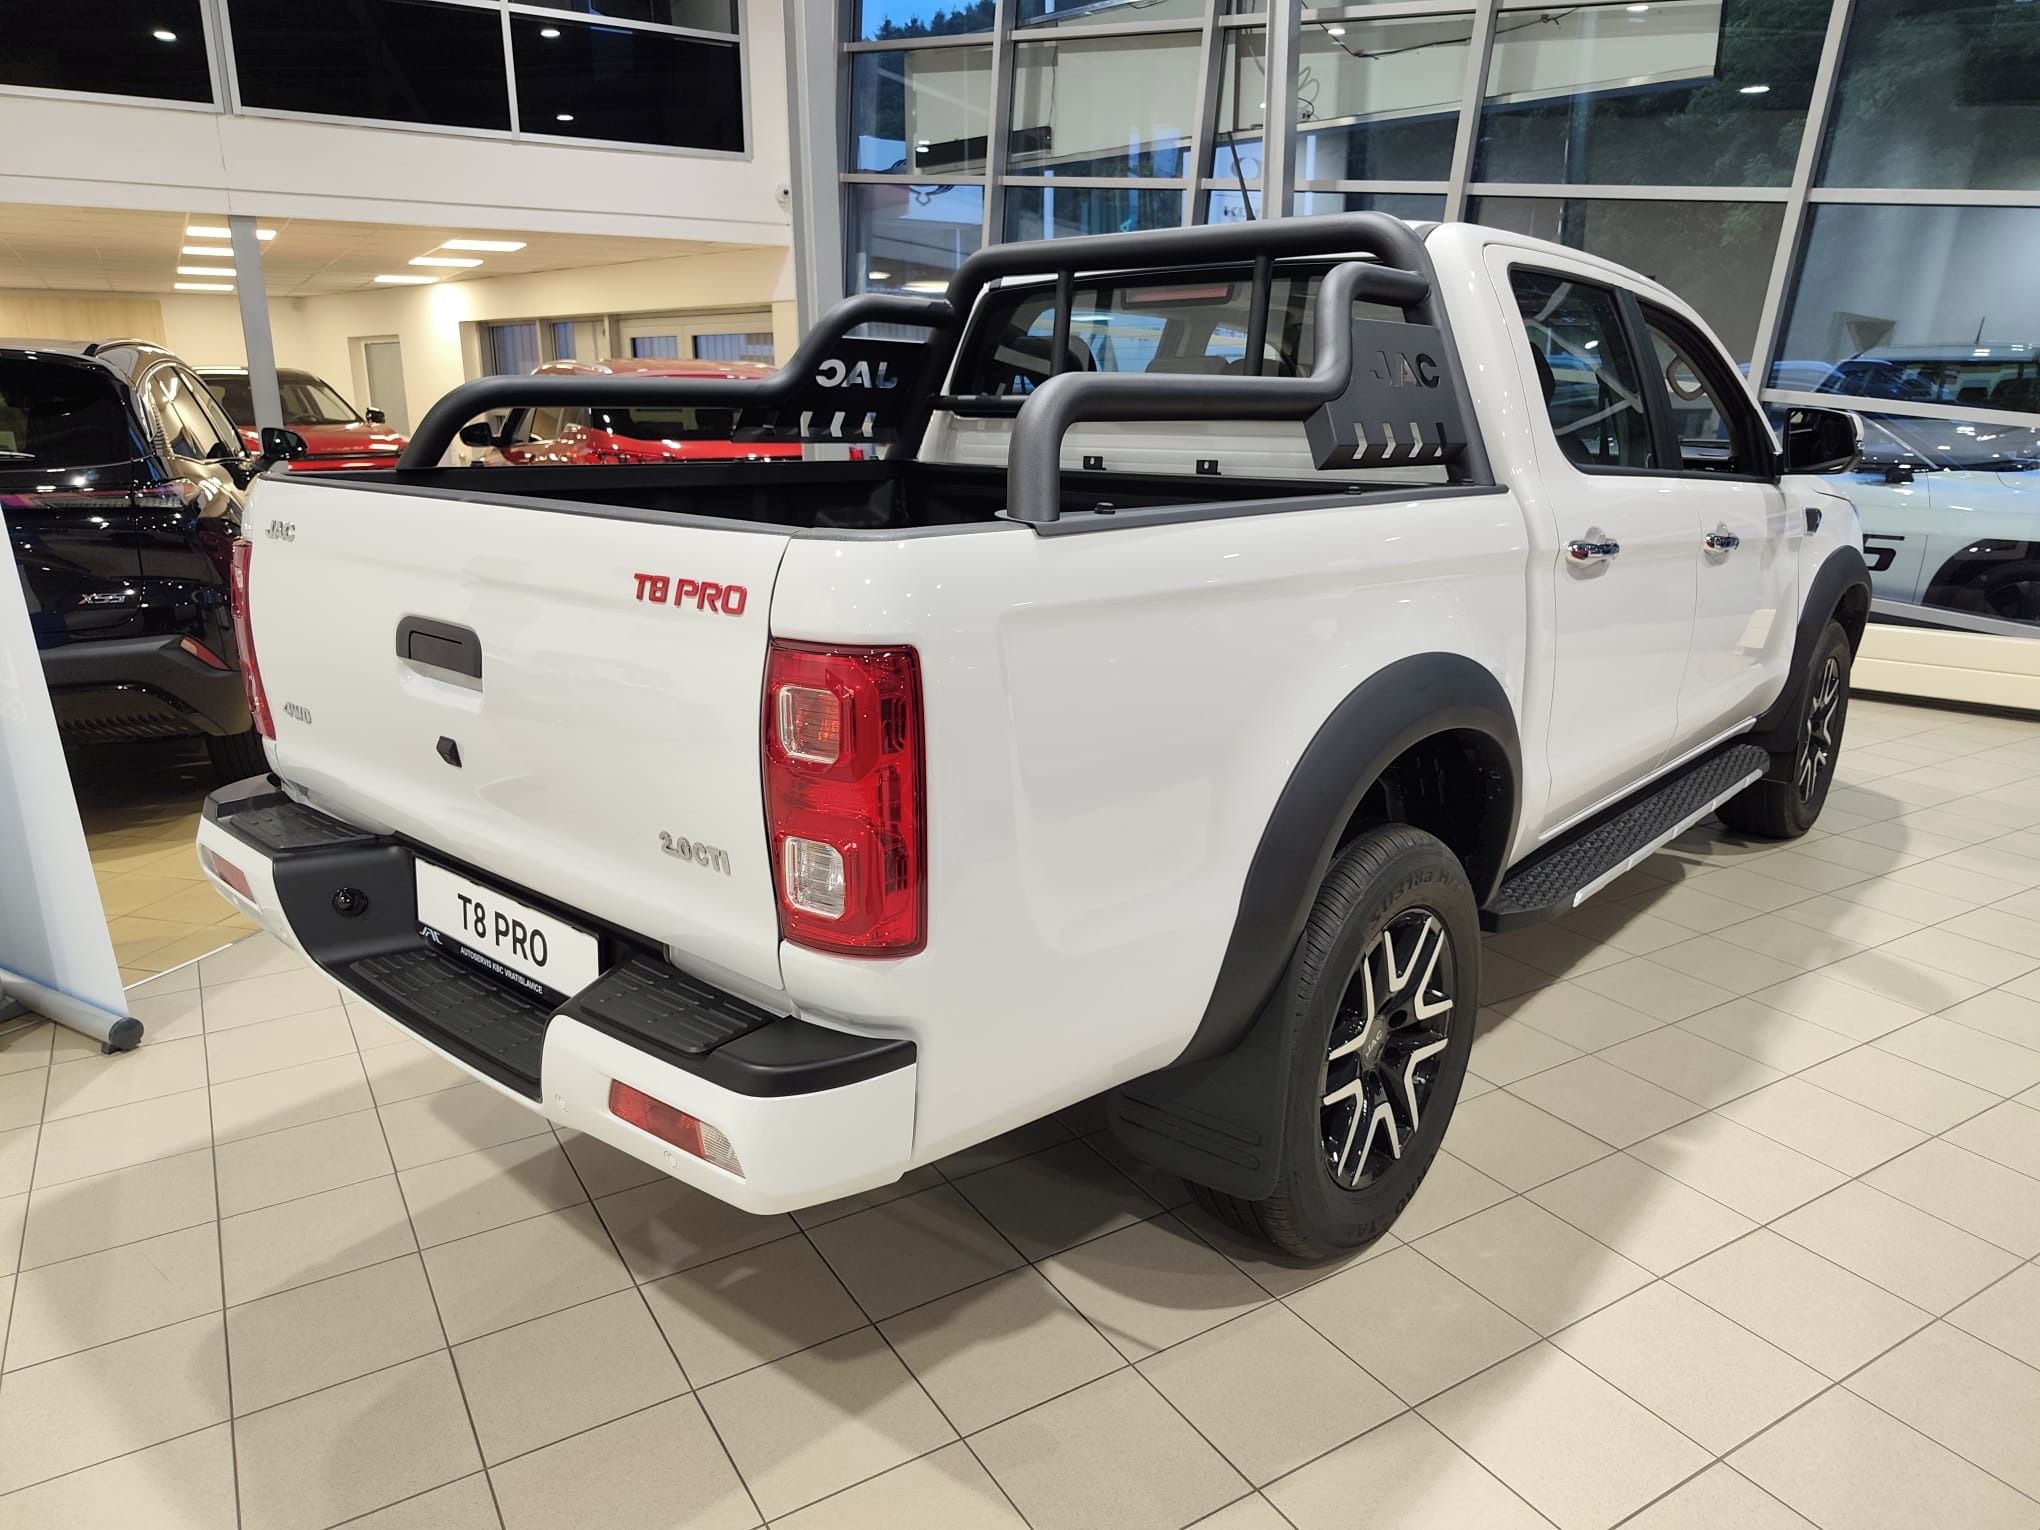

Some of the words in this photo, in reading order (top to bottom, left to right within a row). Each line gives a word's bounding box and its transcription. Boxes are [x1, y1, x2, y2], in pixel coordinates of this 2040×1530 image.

[1368, 350, 1440, 389] JAC
[264, 519, 296, 543] JAC
[634, 573, 671, 604] T8
[674, 578, 748, 617] PRO
[658, 830, 731, 876] 2.0CTI
[457, 893, 487, 939] T8
[494, 910, 548, 967] PRO
[460, 946, 492, 969] AUTOSERVIS
[504, 968, 543, 995] VRATISLAVICE
